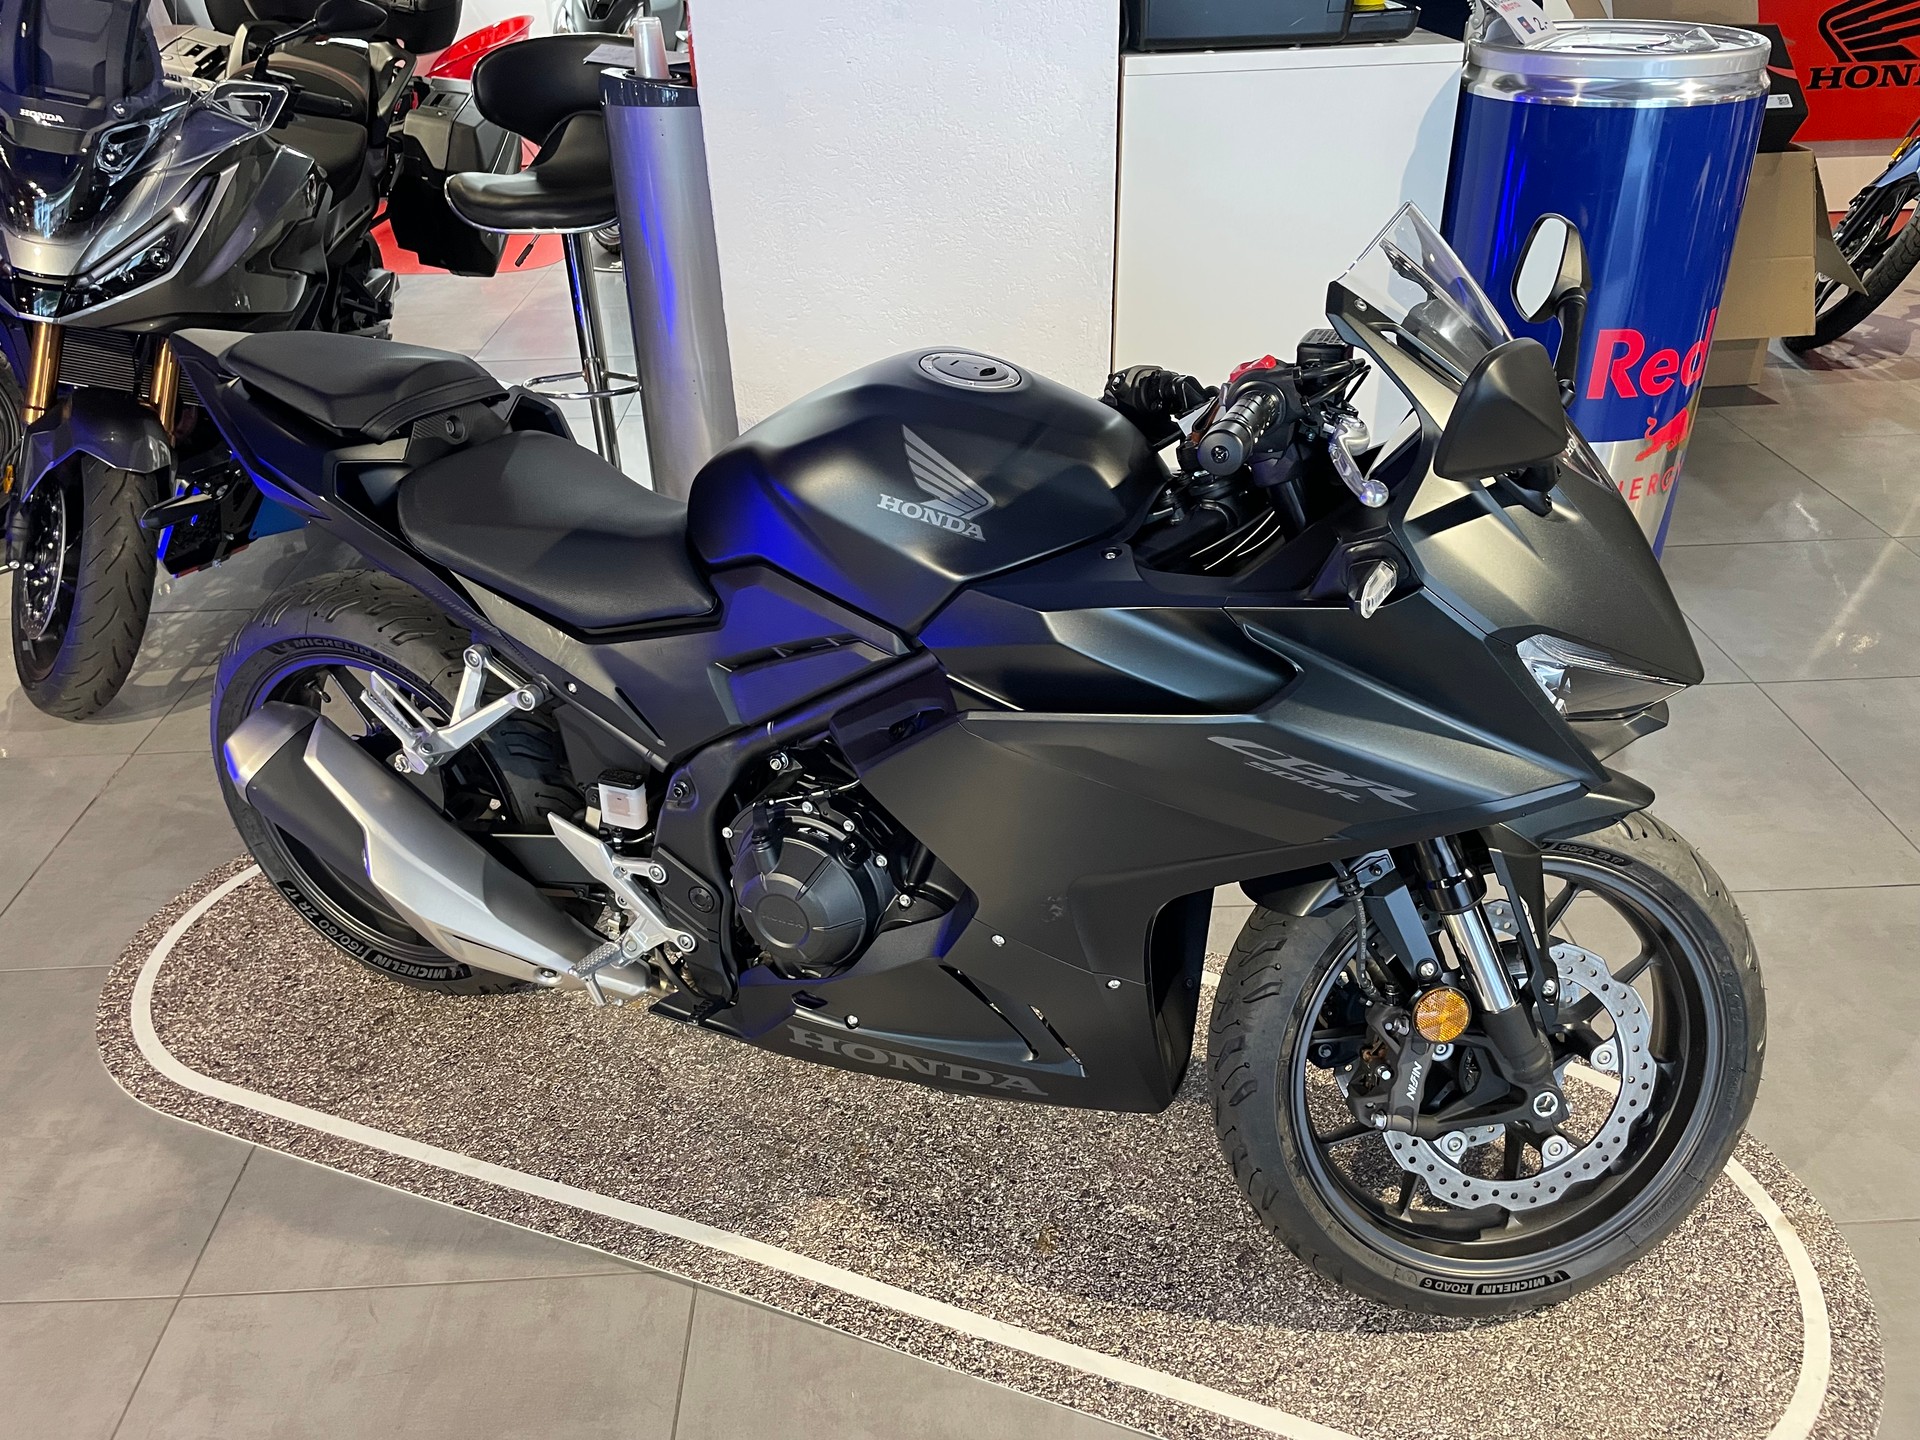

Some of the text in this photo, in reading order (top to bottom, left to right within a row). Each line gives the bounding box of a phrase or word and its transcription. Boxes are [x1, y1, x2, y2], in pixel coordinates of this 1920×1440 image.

[1805, 63, 1920, 90] HON
[19, 108, 65, 123] HONDA
[1586, 307, 1717, 400] Red
[876, 493, 987, 542] HONDA
[293, 636, 373, 657] MICHELIN
[1207, 736, 1419, 812] CBR
[283, 886, 448, 980] MICHELIN 160/60 ZR 17
[786, 1024, 1049, 1097] HONDA
[1405, 1060, 1423, 1101] NISSIN
[1423, 1276, 1546, 1294] MICHELIN ROAD 6
